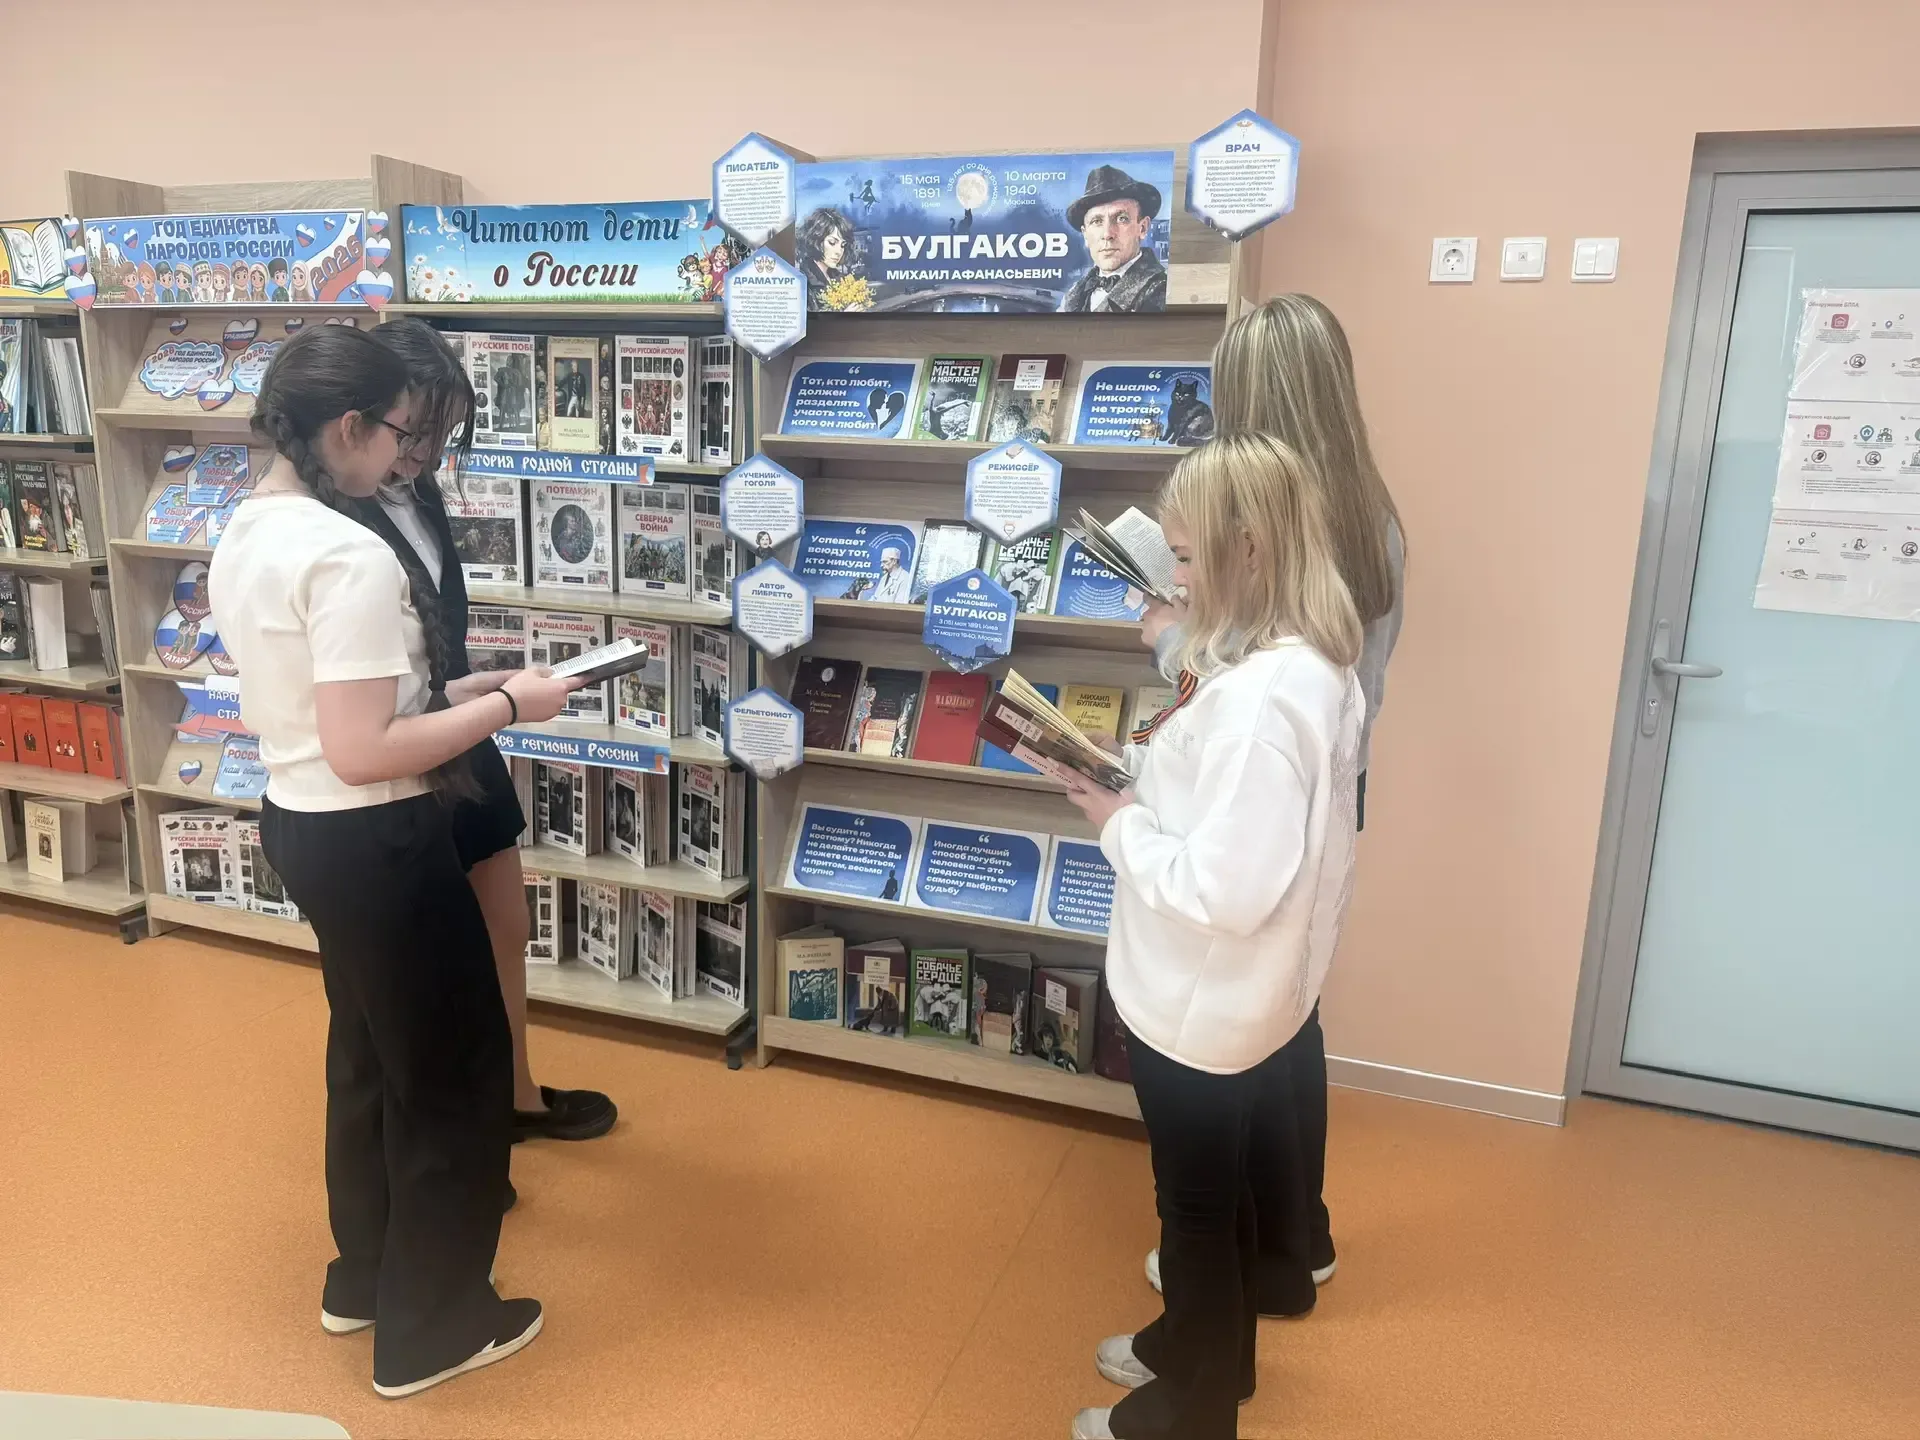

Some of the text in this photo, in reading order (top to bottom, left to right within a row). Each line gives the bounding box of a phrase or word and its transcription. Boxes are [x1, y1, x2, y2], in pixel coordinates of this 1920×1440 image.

[1225, 144, 1260, 152] ВРАЧ
[726, 162, 779, 172] ПИСАТЕЛЬ
[977, 163, 992, 176] дня
[900, 174, 940, 184] 15 мая
[1004, 171, 1066, 183] 10 марта
[914, 188, 940, 198] 1891
[1004, 185, 1037, 196] 1940
[152, 216, 280, 238] ГОД ЕДИНСТВА
[452, 208, 680, 243] Читают дети
[145, 238, 294, 261] НАРОДОВ РОССИИ
[882, 232, 1068, 260] БУЛГАКОВ
[310, 235, 363, 288] 2026
[494, 250, 639, 288] о России
[886, 268, 1062, 281] МИХАИЛ АФАНАСЬЕВИЧ
[734, 276, 796, 286] ДРАМАТУРГ
[472, 341, 534, 352] РУССКИЕ ПОБЕ
[152, 346, 175, 364] 2026
[240, 346, 264, 364] 2026
[932, 366, 980, 376] МАСТЕР
[802, 376, 826, 386] Тот,
[848, 378, 892, 388] любит,
[1096, 382, 1161, 392] Не шалю,
[204, 392, 226, 400] МИР
[798, 388, 846, 396] должен
[796, 399, 860, 407] разделять
[792, 409, 866, 419] участь того,
[1110, 406, 1164, 415] трогаю,
[836, 421, 876, 430] любит
[1088, 417, 1152, 425] починяю
[1086, 428, 1140, 438] примус
[465, 453, 638, 476] СТОРИЯ РОДНОЙ СТРАНЫ
[988, 462, 1040, 472] РЕЖИССЁР
[204, 468, 236, 477] ЛЮБОВЬ
[204, 478, 238, 487] РОДИНЕ
[546, 486, 598, 496] ПОТЕМКИН
[164, 508, 192, 517] ОБЩАЯ
[488, 508, 496, 516] III
[149, 518, 200, 528] ТЕРРИТОРИЯ
[636, 513, 674, 524] СЕВЕРНАЯ
[695, 518, 715, 528] РУССКИЕ
[640, 522, 668, 532] ВОЙНА
[811, 535, 866, 546] Успевает
[808, 546, 870, 558] всюду тот,
[1000, 544, 1049, 560] СЕРДЦЕ
[805, 557, 872, 568] кто никуда
[818, 568, 880, 580] торопится
[1071, 568, 1090, 577] не
[759, 582, 786, 590] АВТОР
[752, 589, 793, 600] ЛИБРЕТТО
[956, 591, 988, 601] МИХАИЛ
[945, 596, 998, 608] АФАНАСЬЕВИЧ
[180, 603, 211, 615] РУССКИ
[933, 604, 1007, 622] БУЛГАКОВ
[533, 621, 595, 632] МАРШАЛ ПОБЕДЫ
[618, 626, 666, 642] ГОРОДА РОССИИ
[977, 634, 1002, 643] Москва
[163, 652, 190, 664] ТАТАРЫ
[1080, 694, 1110, 702] МИХАИЛ
[1076, 700, 1111, 708] БУЛГАКОВ
[734, 708, 792, 719] ФЕЛЬЕТОНИСТ
[491, 732, 640, 762] Все регионы России
[228, 749, 261, 761] РОССИ
[223, 766, 240, 774] наш
[231, 779, 252, 792] дом!
[812, 824, 871, 838] Вы судите по
[809, 832, 896, 850] костюму? Никогда
[819, 842, 858, 853] делайте
[858, 848, 886, 858] этого.
[888, 852, 902, 860] Вы
[933, 840, 1010, 857] Иногда лучший
[805, 850, 896, 868] можете ошибиться,
[932, 849, 1012, 867] способ погубить
[810, 858, 848, 871] притом,
[848, 864, 883, 875] весьма
[930, 858, 1004, 874] человека это
[1064, 858, 1109, 872] Никогда
[801, 866, 834, 877] крупно
[928, 868, 1018, 886] предоставить ему
[1064, 868, 1077, 876] не
[926, 876, 1008, 893] самому выбрать
[1062, 876, 1106, 890] Никогда
[924, 884, 960, 896] судьбу
[1058, 895, 1076, 904] кто
[1056, 904, 1086, 915] Сами
[1064, 914, 1092, 926] сами
[916, 960, 962, 974] СОБАЧЬЕ
[916, 970, 962, 984] СЕРДЦЕ
